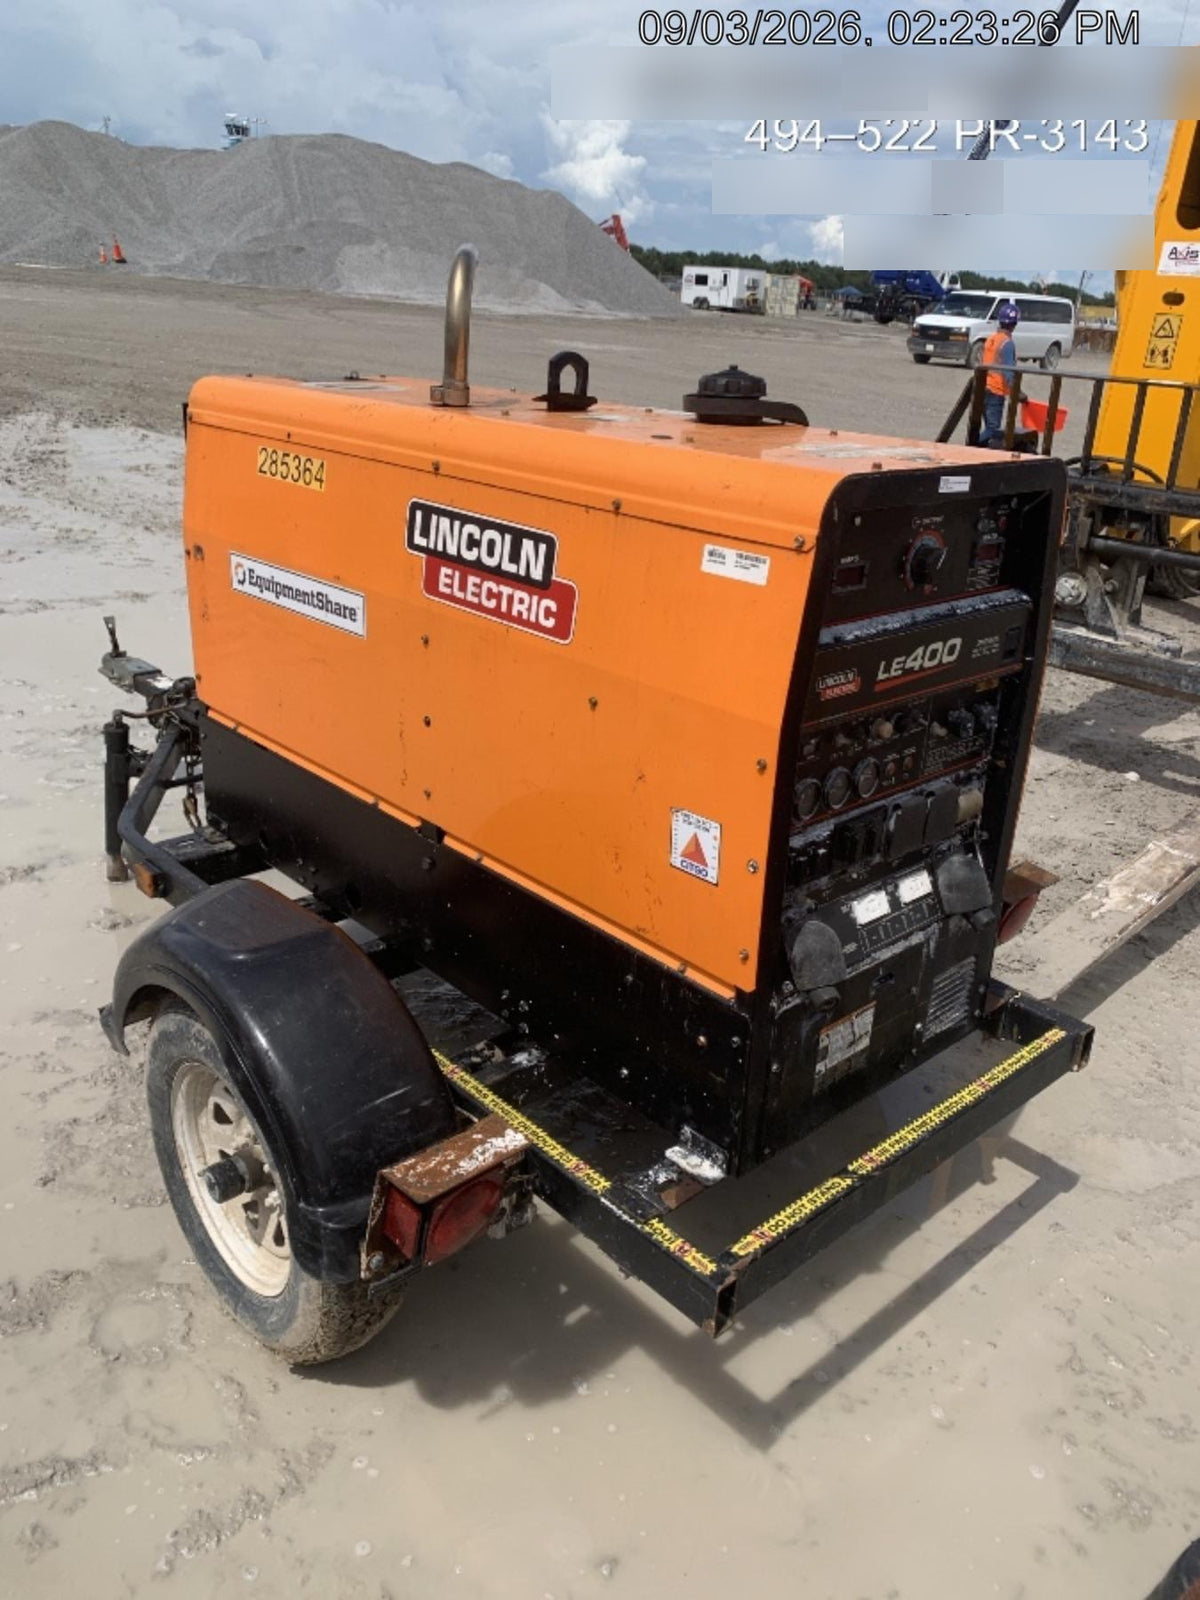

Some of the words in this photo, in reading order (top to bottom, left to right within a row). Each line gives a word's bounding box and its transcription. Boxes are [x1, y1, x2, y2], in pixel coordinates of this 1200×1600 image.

[258, 448, 325, 490] 285364
[413, 510, 547, 581] LINCOLN
[247, 568, 358, 622] EquipmentShare
[438, 567, 557, 629] ELECTRIC
[877, 637, 962, 681] LE400
[768, 1218, 784, 1233] DO
[787, 1203, 807, 1221] NOT
[808, 1180, 842, 1204] STAND
